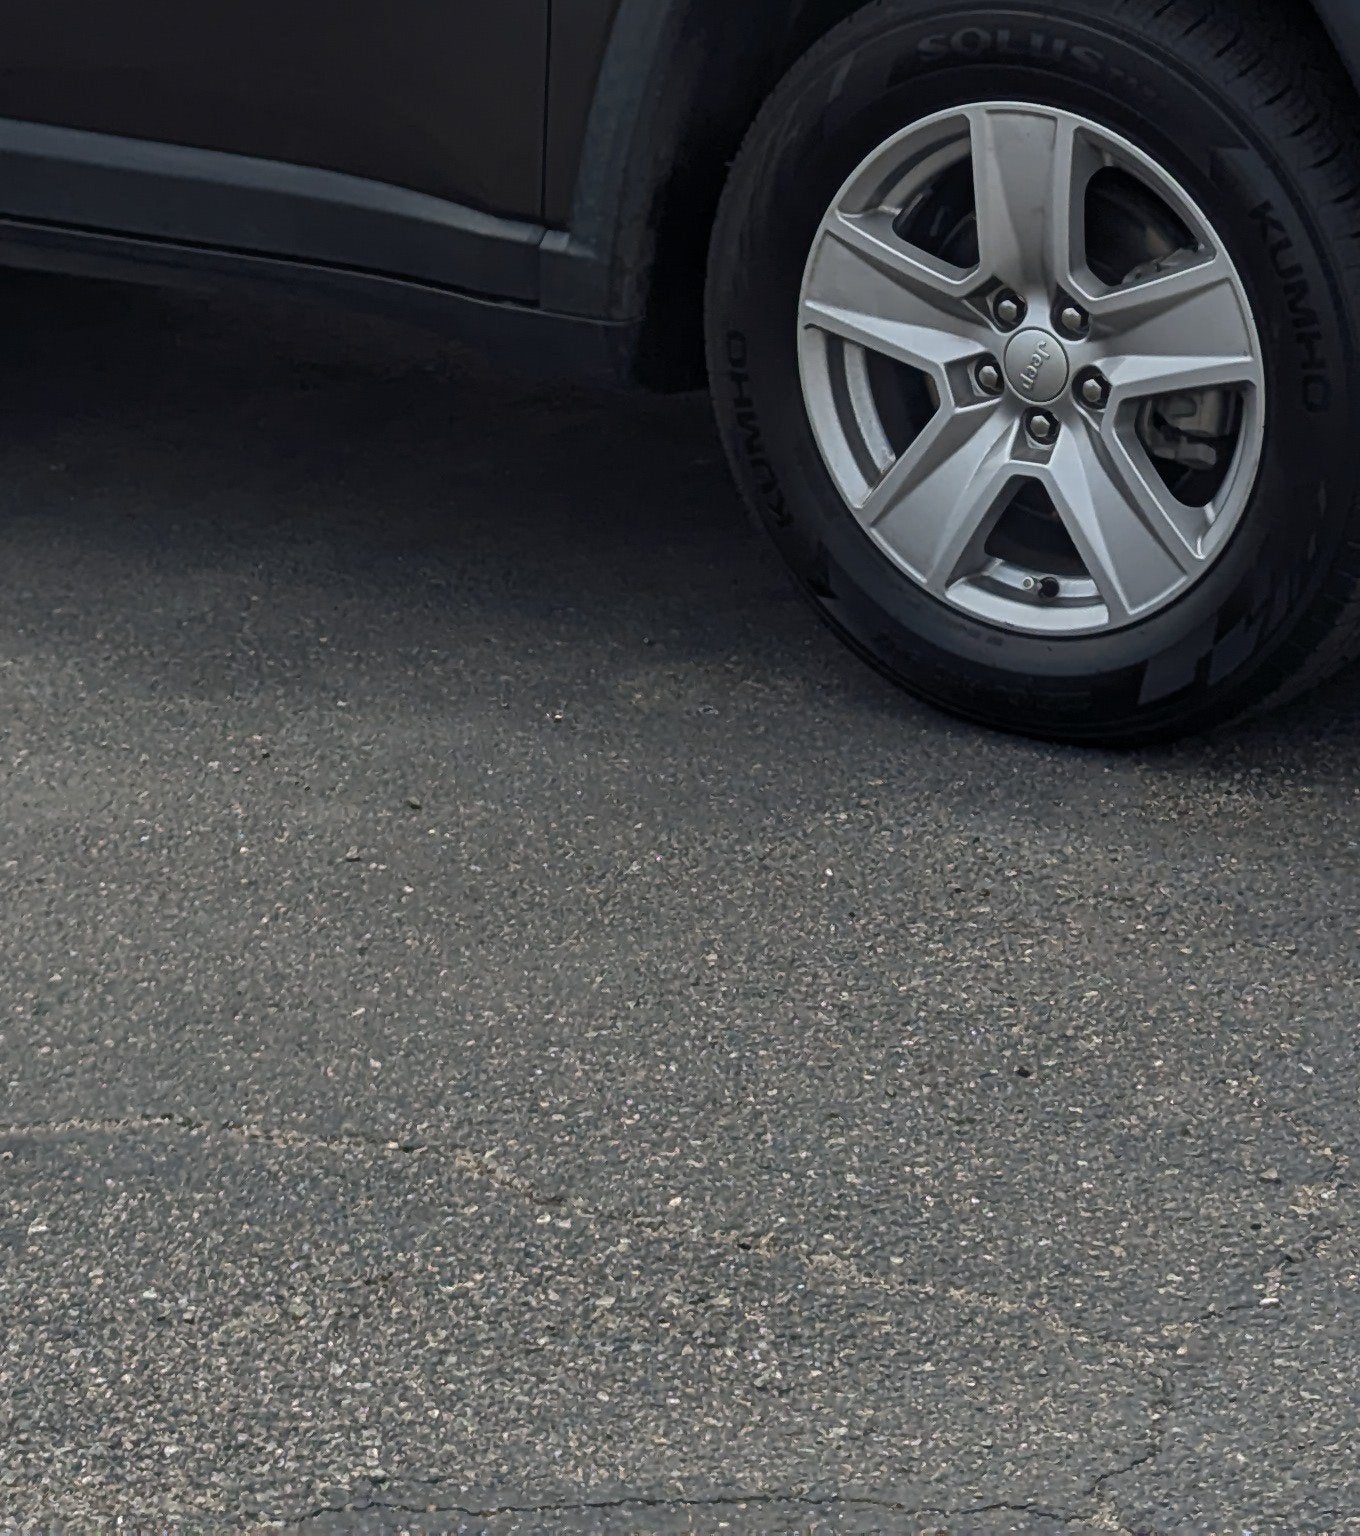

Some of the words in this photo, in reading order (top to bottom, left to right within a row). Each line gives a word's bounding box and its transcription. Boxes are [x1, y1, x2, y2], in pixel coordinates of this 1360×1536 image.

[916, 26, 1106, 74] SOLUS
[1019, 339, 1051, 391] Jeep
[1247, 199, 1332, 414] KUMHO
[724, 328, 795, 529] KUMHO
